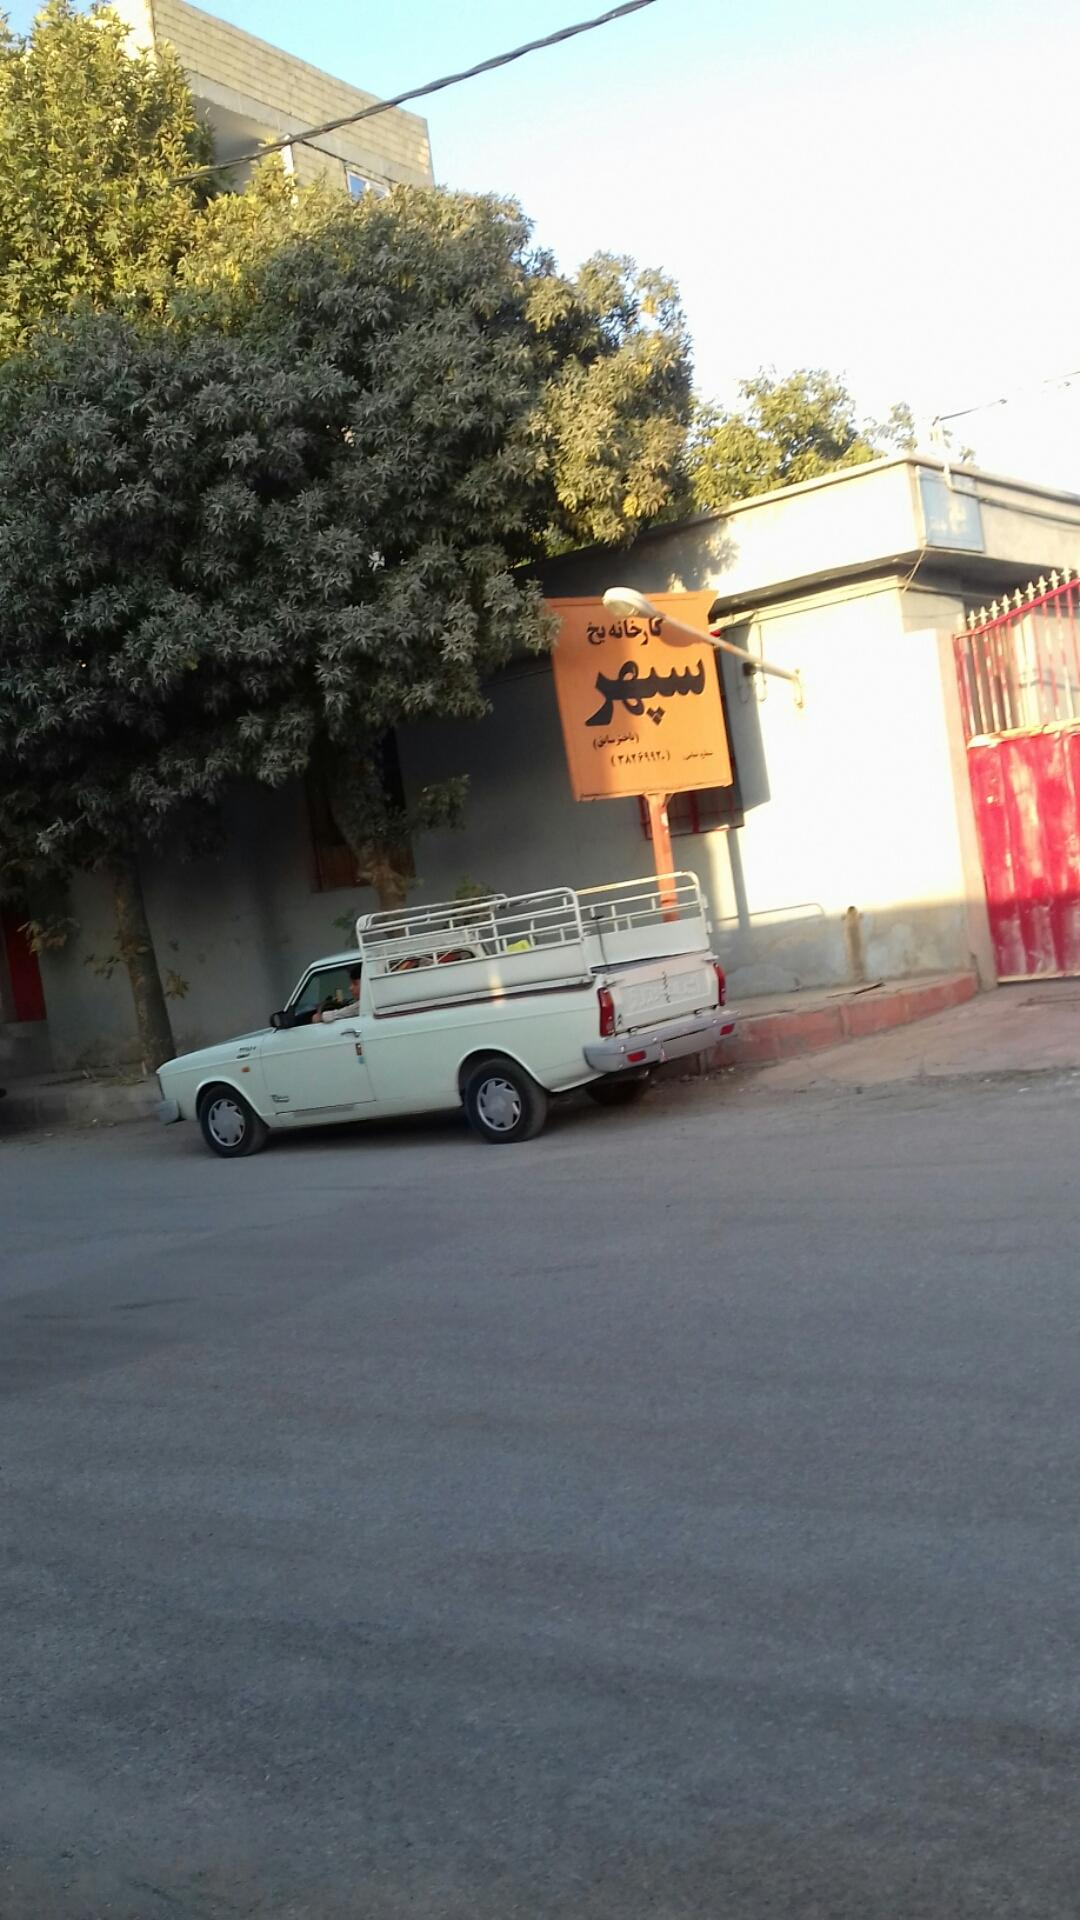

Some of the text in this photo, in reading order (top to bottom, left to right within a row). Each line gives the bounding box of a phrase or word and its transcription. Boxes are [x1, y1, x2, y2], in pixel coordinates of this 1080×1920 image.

[586, 617, 663, 645] کارخانه یخ
[585, 659, 706, 727] سپهر
